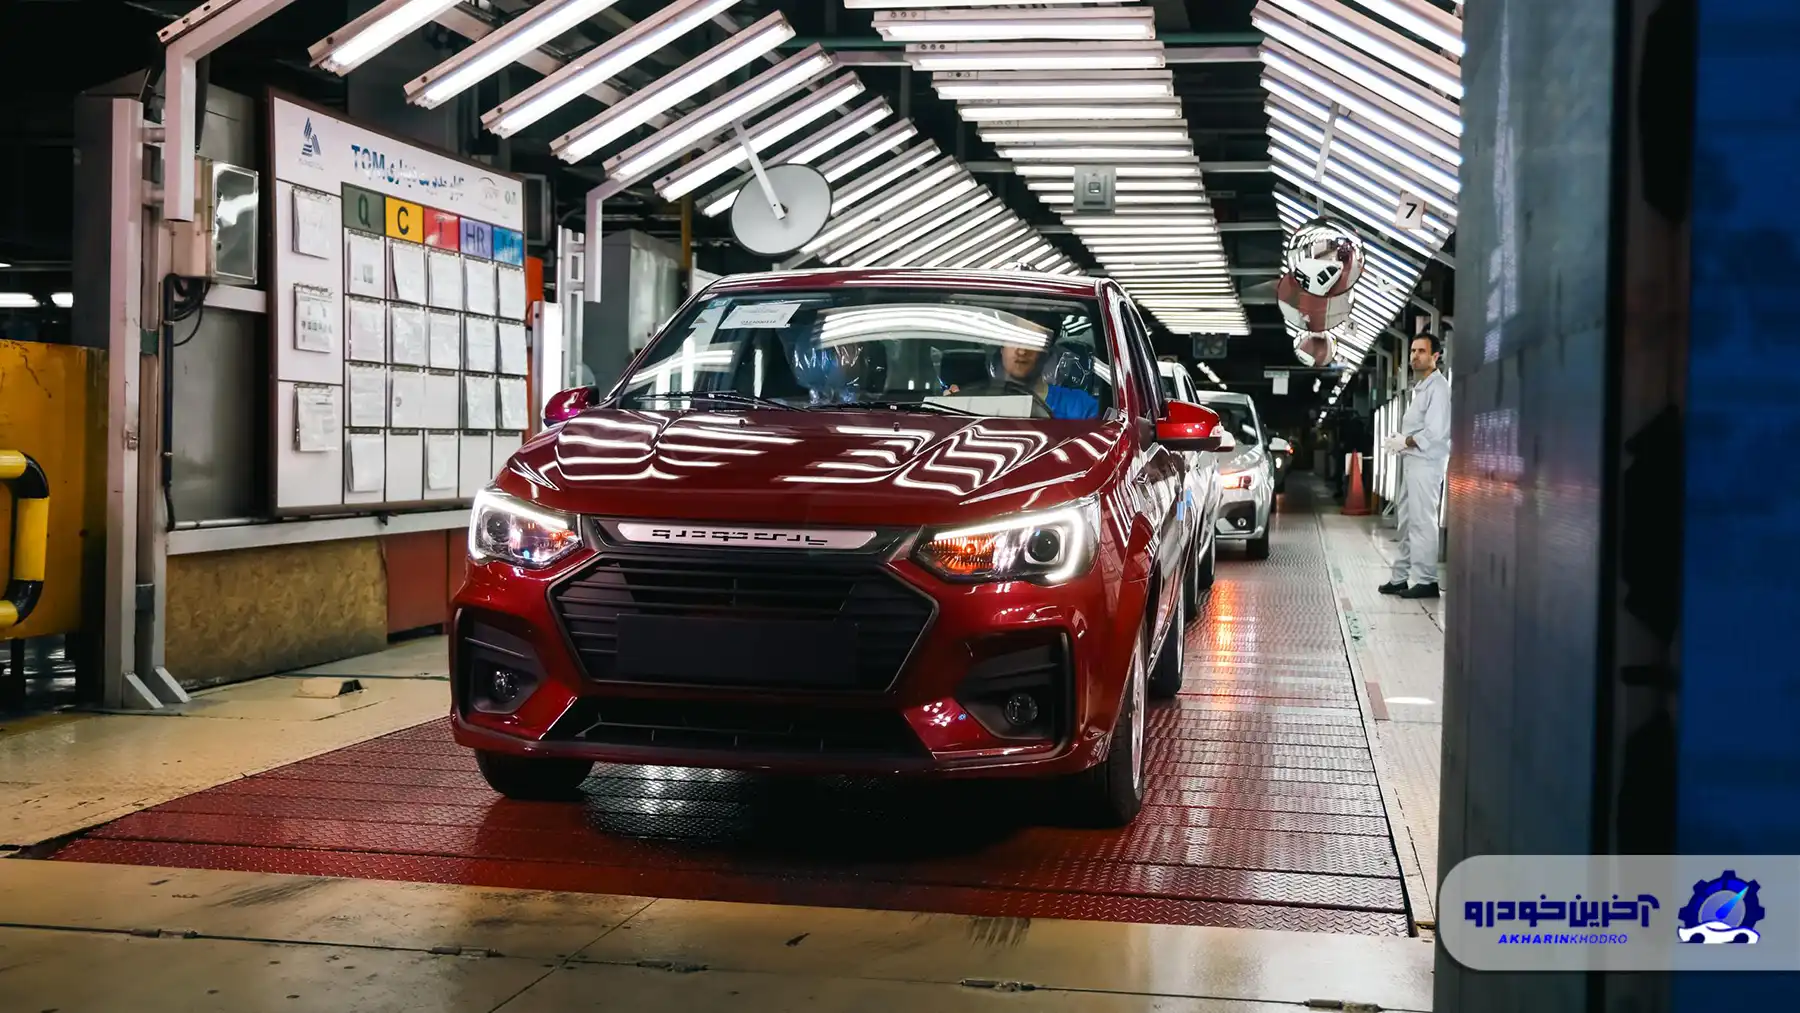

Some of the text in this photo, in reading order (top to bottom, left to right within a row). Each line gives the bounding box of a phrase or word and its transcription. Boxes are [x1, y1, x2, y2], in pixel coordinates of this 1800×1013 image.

[358, 194, 371, 229] Q
[397, 206, 409, 235] C
[1406, 202, 1417, 219] 7
[465, 223, 486, 254] HR
